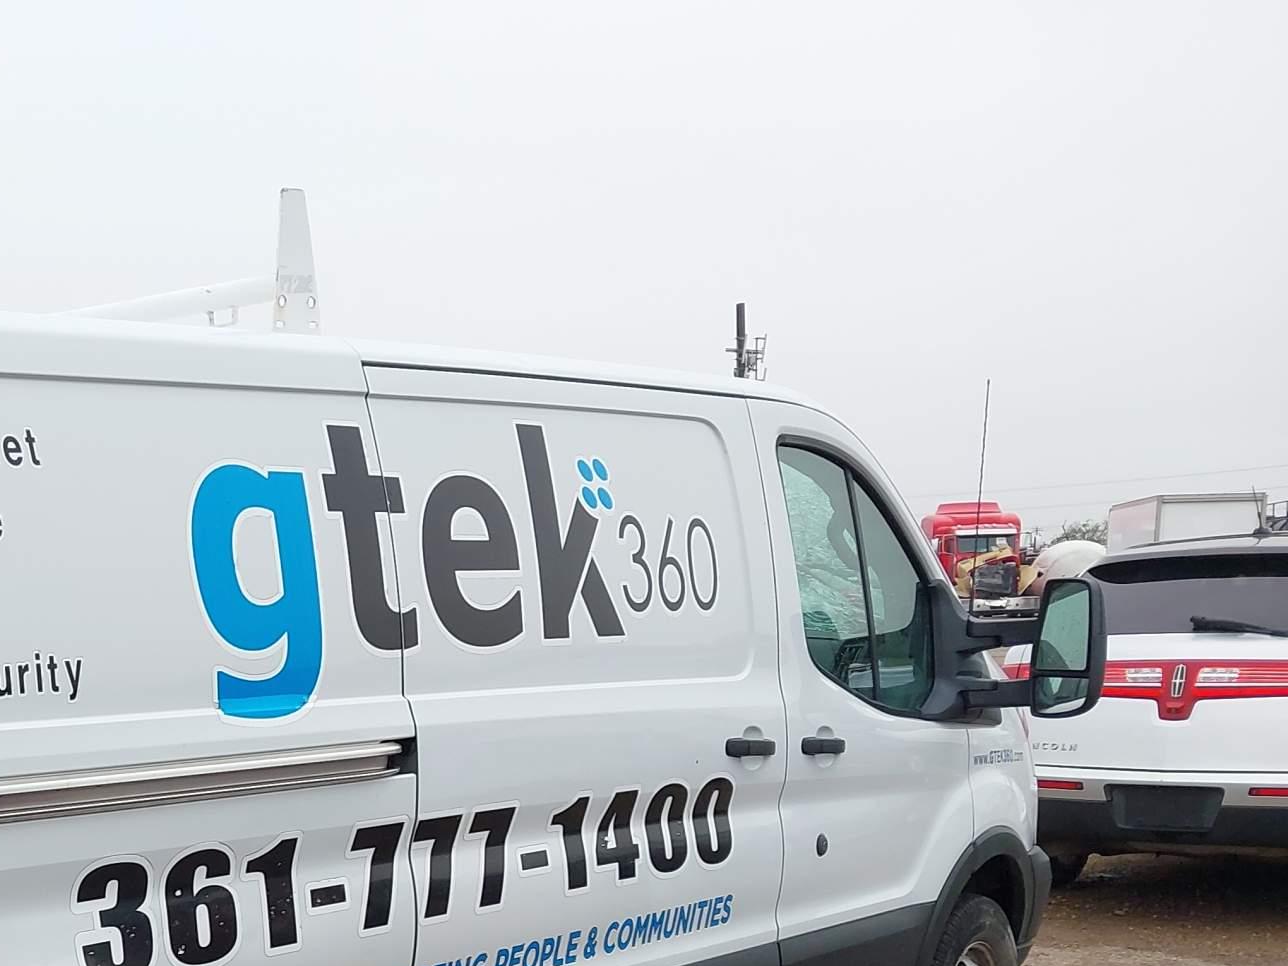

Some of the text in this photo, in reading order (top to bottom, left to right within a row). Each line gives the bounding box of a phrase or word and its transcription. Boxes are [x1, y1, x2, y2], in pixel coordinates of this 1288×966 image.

[1032, 742, 1078, 751] NCOLN
[583, 925, 598, 960] &
[603, 894, 734, 954] COMMUNITIES
